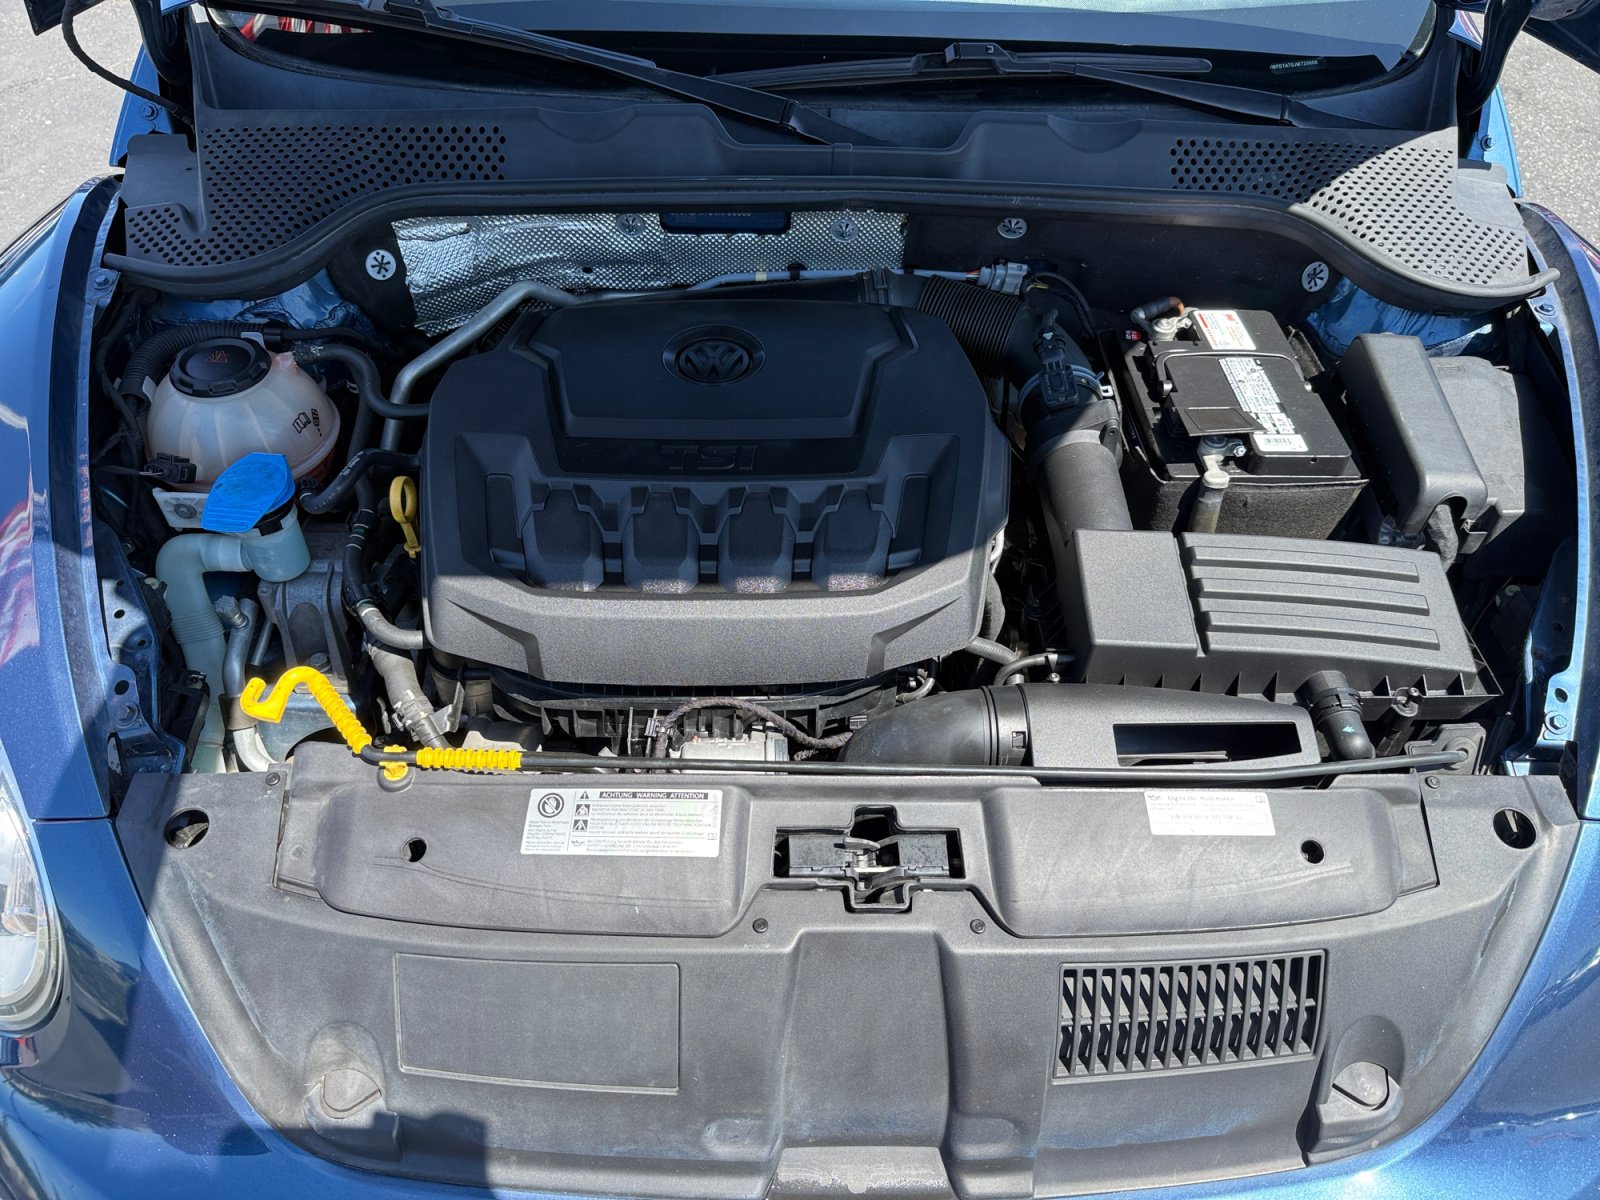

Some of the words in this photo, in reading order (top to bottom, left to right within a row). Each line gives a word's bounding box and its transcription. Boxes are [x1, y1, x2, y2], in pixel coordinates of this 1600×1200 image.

[660, 444, 758, 471] TSI
[636, 792, 667, 800] WARNING
[669, 792, 705, 800] ATTENTION
